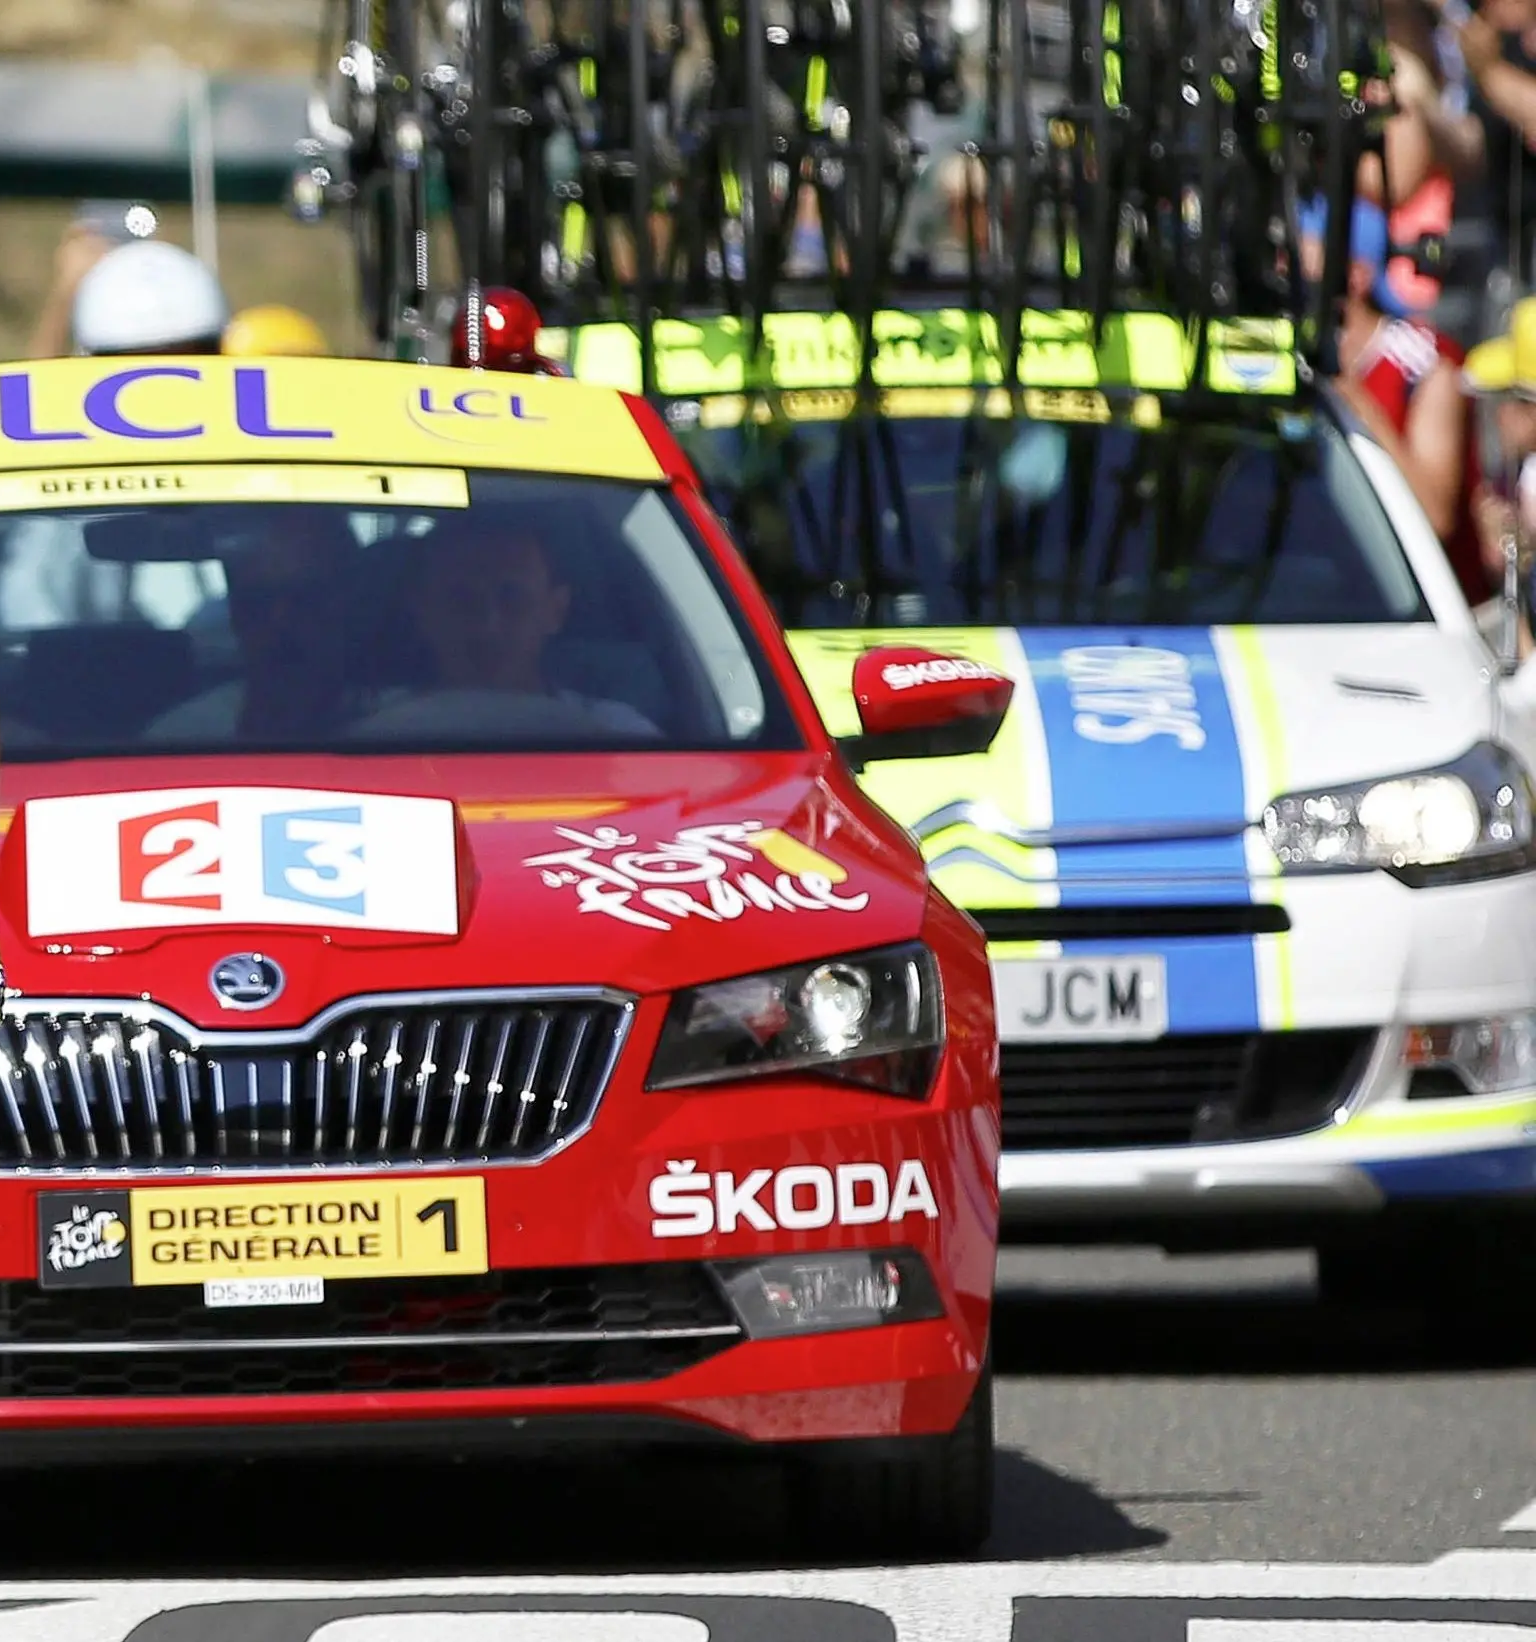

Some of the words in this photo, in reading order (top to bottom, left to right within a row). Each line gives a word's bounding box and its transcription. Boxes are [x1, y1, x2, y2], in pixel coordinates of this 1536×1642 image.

[419, 387, 547, 421] LCL
[41, 477, 187, 494] OFFICIEL
[368, 474, 394, 494] 1
[140, 817, 221, 900] 2
[283, 817, 367, 899] 3
[1022, 967, 1141, 1026] JCM
[149, 1201, 380, 1231] DIRECTION
[416, 1198, 459, 1253] 1
[649, 1159, 940, 1237] ŠKODA
[151, 1231, 382, 1264] GÉNÉRALE
